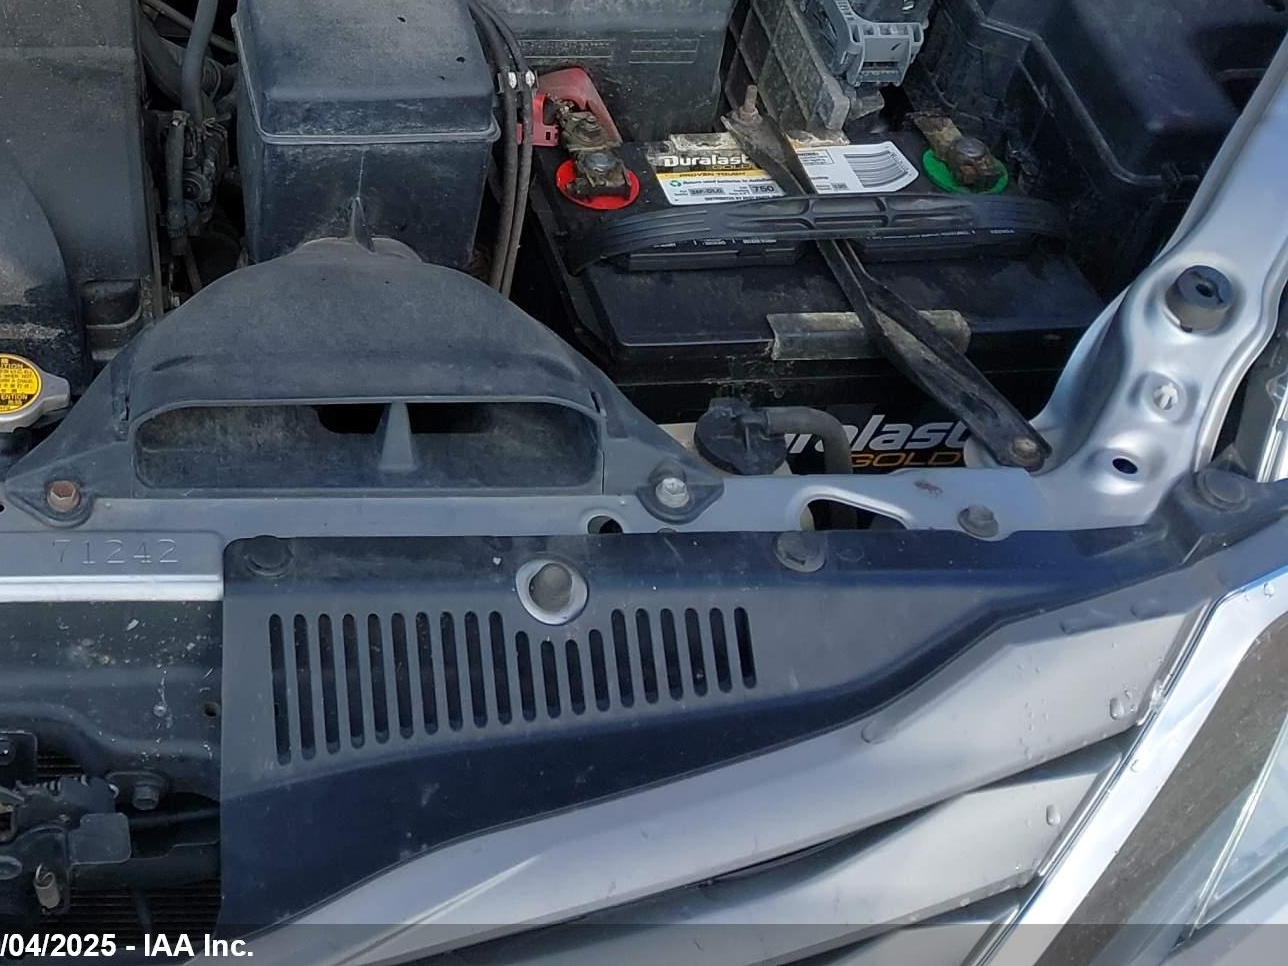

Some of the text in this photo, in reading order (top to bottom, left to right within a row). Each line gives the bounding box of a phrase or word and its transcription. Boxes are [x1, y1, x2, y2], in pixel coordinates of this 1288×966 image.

[660, 154, 749, 167] Duralast
[753, 185, 775, 193] 750
[784, 415, 968, 454] last
[851, 452, 961, 468] GOLD
[52, 538, 179, 564] 71242
